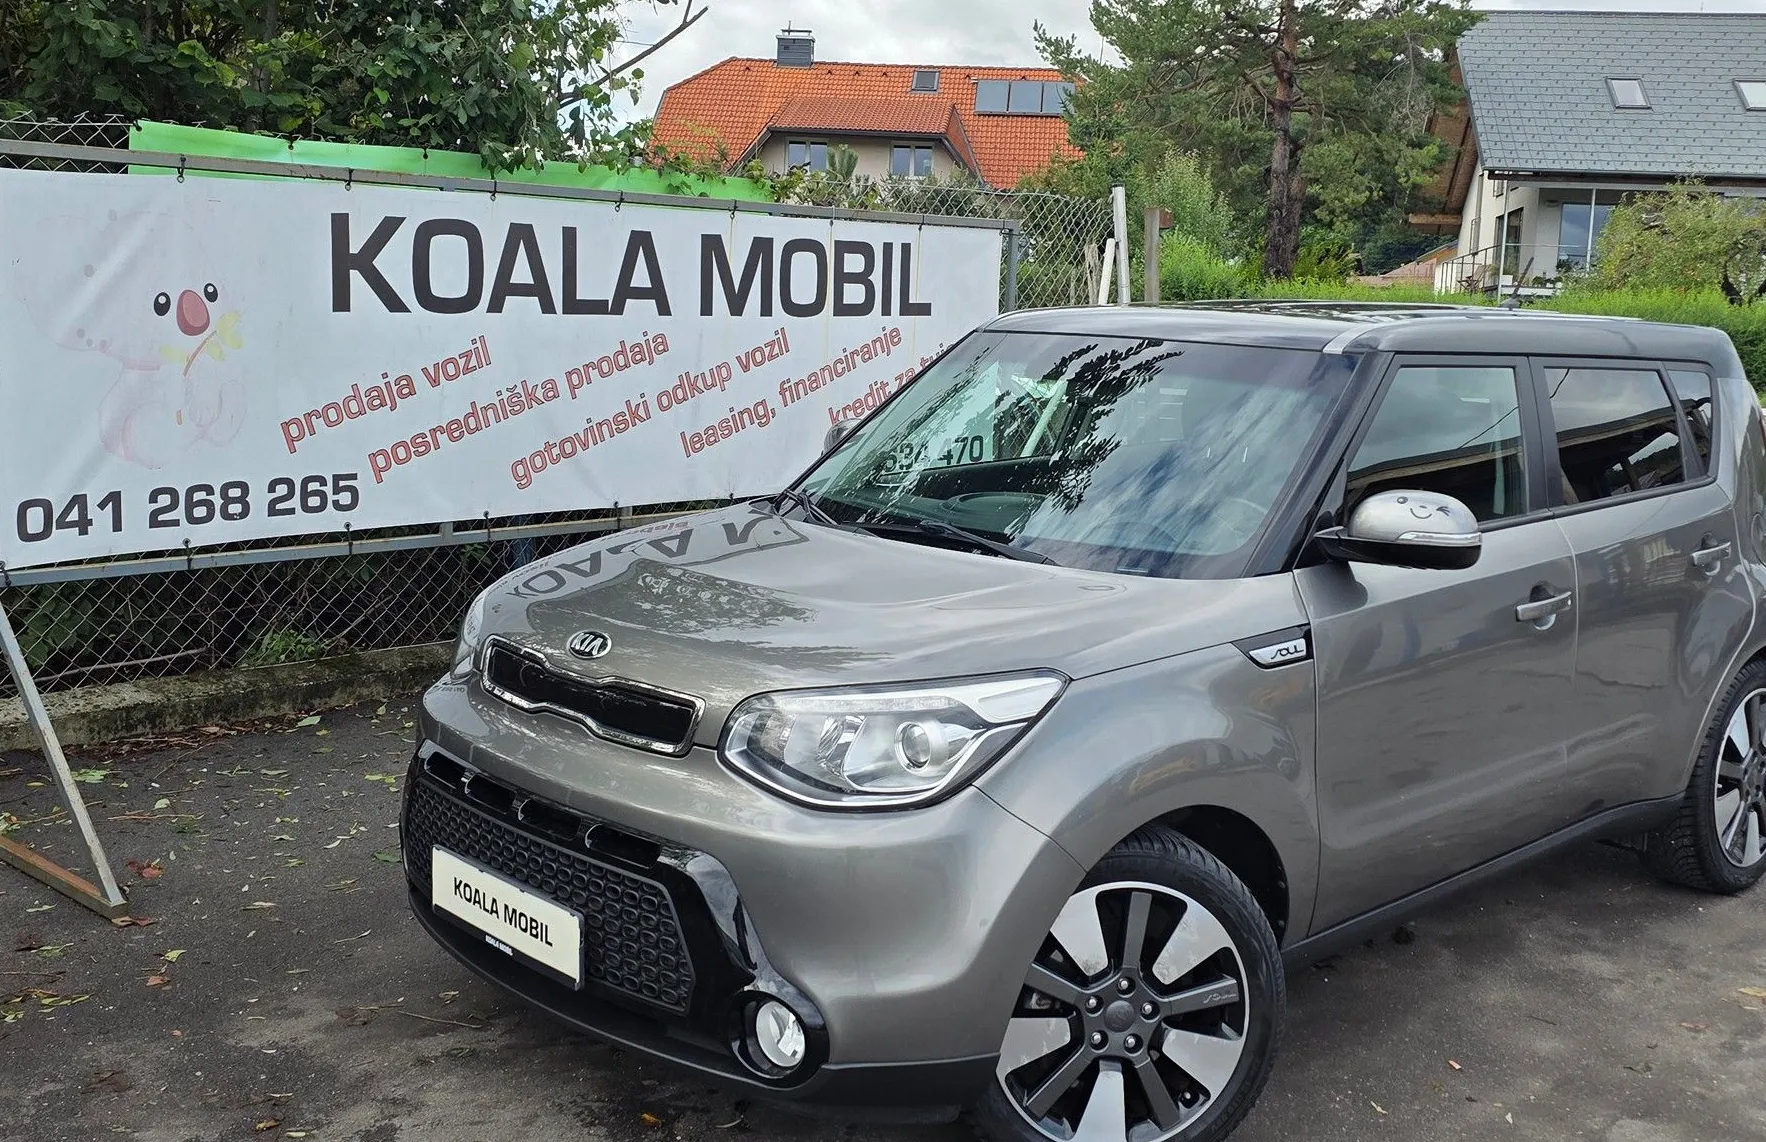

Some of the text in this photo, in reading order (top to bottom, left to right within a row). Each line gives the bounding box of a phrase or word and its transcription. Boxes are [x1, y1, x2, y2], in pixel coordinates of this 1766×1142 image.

[331, 212, 931, 317] KOALA MOBIL
[280, 335, 492, 454] prodaja vozil
[368, 330, 670, 484] posredniška prodaja
[511, 327, 790, 490] gotovinski odkup vozil
[680, 326, 902, 458] leasing, financiranje
[828, 380, 891, 425] kredit
[17, 473, 360, 543] 041 268 265
[570, 631, 604, 656] KIA
[454, 877, 500, 919] KOALA
[504, 903, 553, 947] MOBIL
